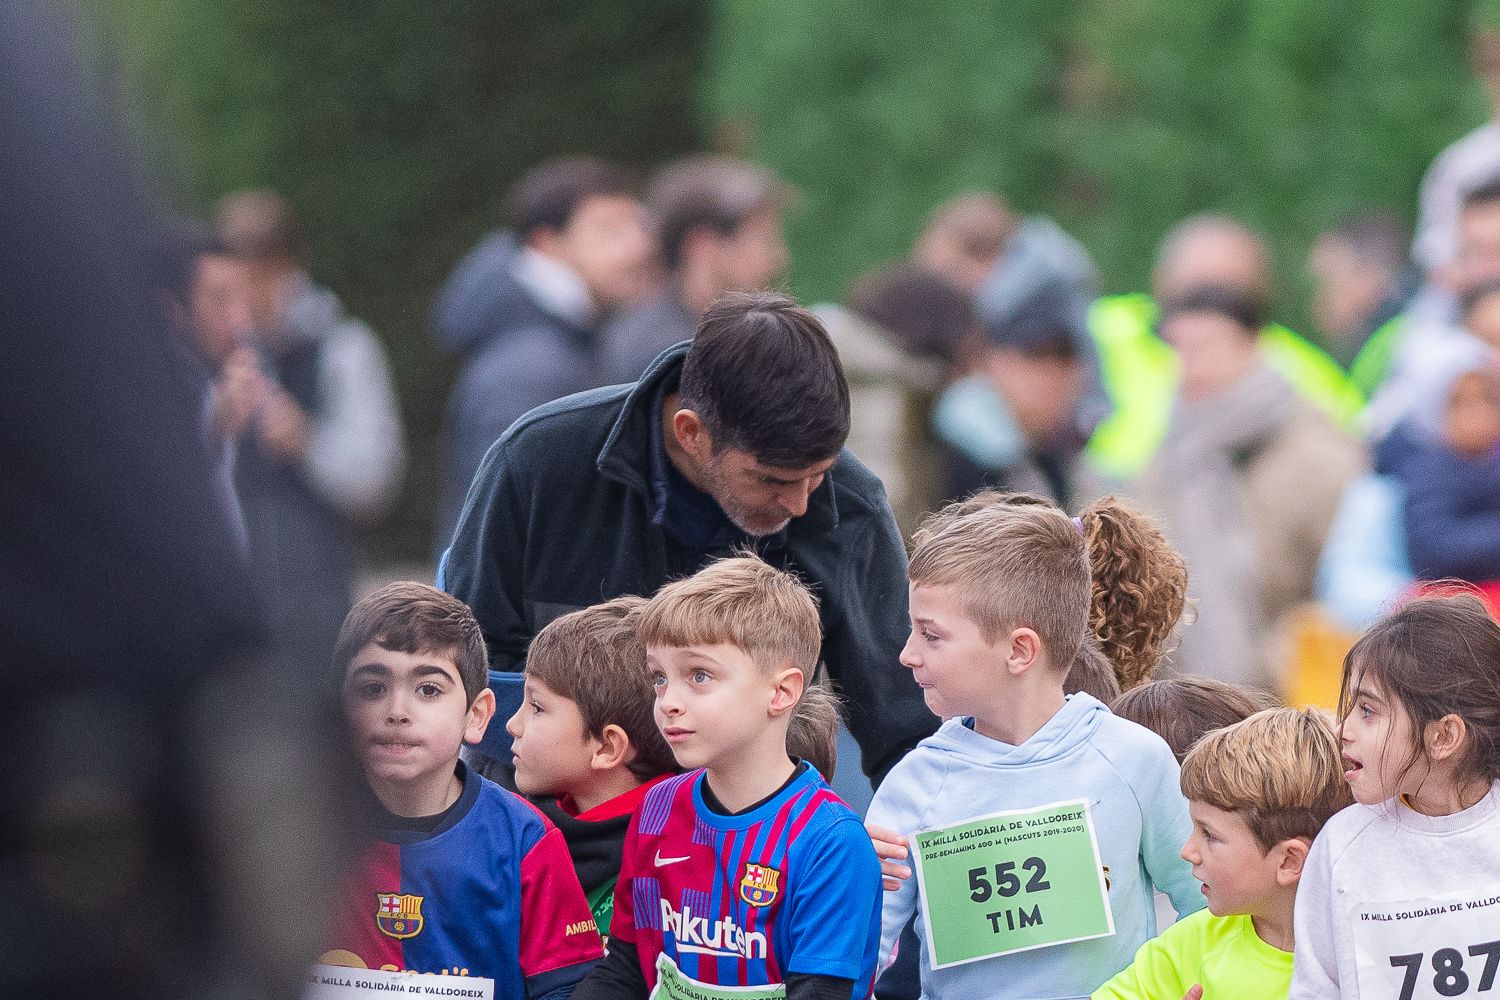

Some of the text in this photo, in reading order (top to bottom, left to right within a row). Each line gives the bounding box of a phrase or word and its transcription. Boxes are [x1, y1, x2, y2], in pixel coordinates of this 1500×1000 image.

[921, 811, 1083, 848] IX MILLA SOLIDÀRIA DE VALLDOREIX
[925, 844, 976, 860] PRE-BENJAMINS
[977, 840, 993, 848] 400
[1004, 831, 1041, 845] (NASCUTS
[1043, 824, 1085, 837] 2019-2020)
[968, 857, 1051, 903] 552
[661, 898, 767, 959] Rakuten
[986, 904, 1043, 934] TIM
[1361, 913, 1370, 921] IX
[1371, 913, 1393, 922] MILLA
[1395, 907, 1447, 920] SOLIDÀRIA
[1450, 903, 1463, 912] DE
[321, 977, 351, 987] MILLA
[355, 980, 405, 993] SOLIDÀRIA
[408, 986, 421, 994] DE
[424, 987, 484, 998] VALLDOREIX
